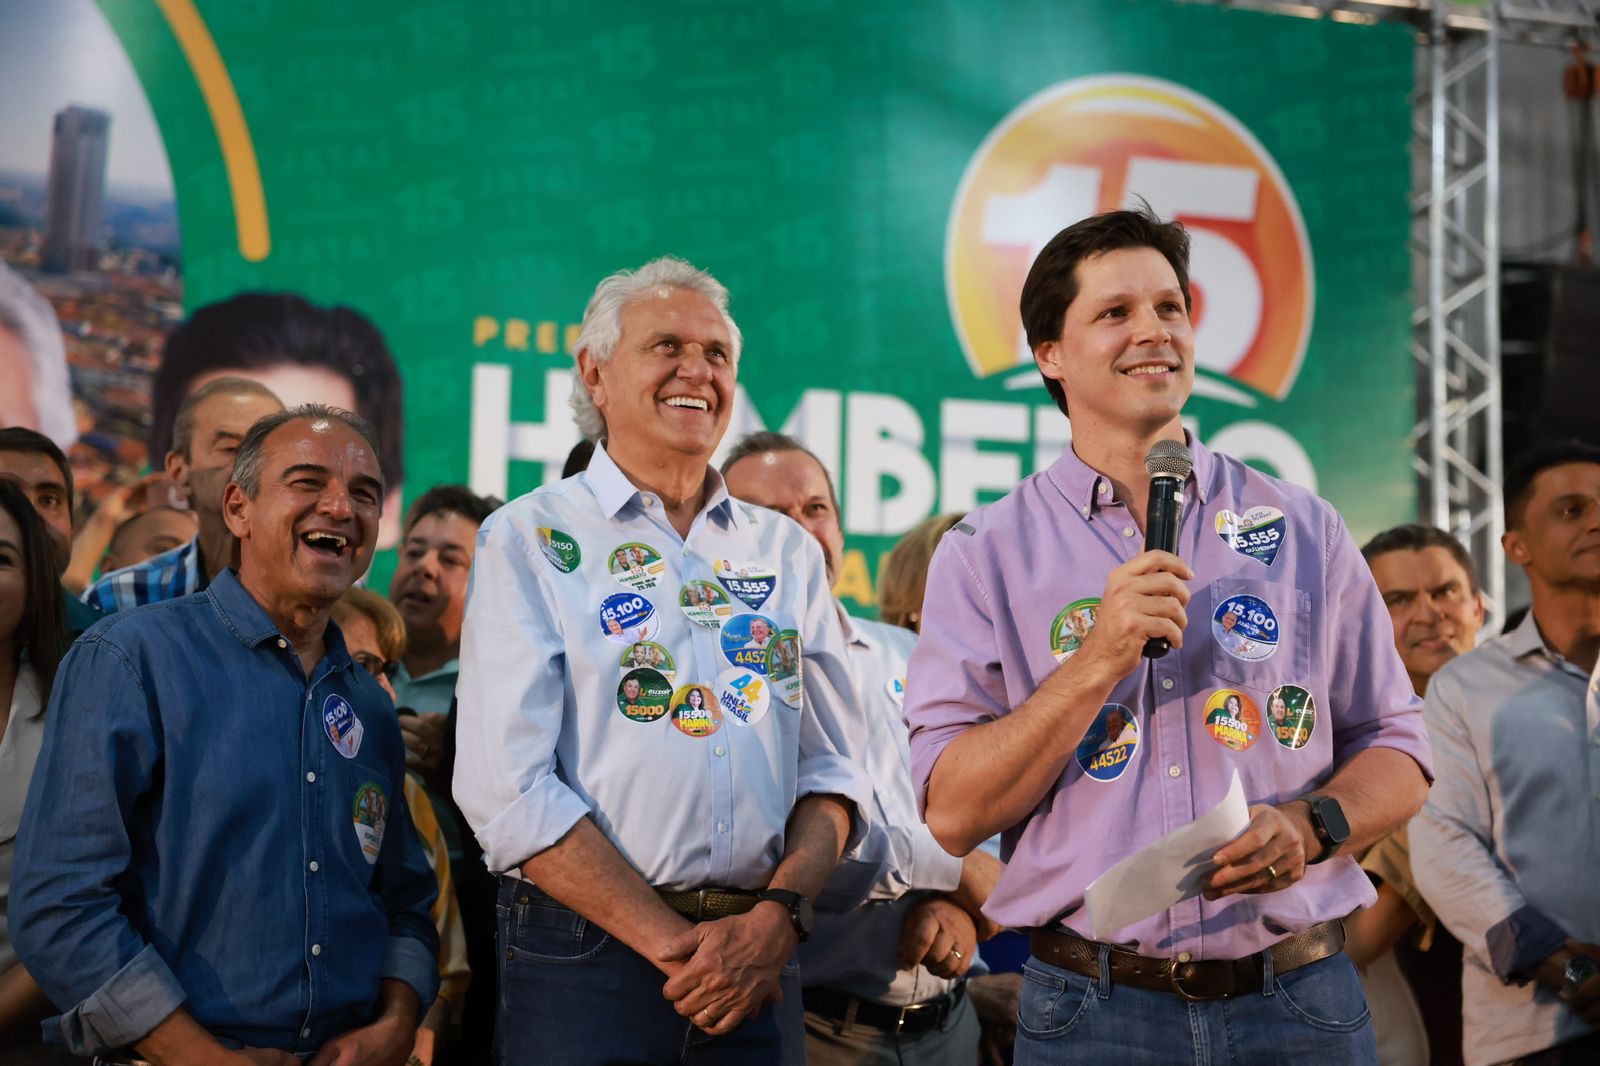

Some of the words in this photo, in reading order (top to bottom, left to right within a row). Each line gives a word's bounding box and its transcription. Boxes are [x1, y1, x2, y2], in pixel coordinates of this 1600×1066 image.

[981, 156, 1263, 373] 15
[469, 362, 1318, 536] HMBEO
[726, 580, 770, 593] 15.555
[602, 597, 644, 621] 15.100
[1228, 602, 1276, 631] 15.100
[325, 701, 347, 727] 15.100
[625, 704, 665, 717] 15000
[678, 710, 713, 719] 15500
[720, 698, 749, 723] BRASIL
[1214, 725, 1248, 744] MARINA
[1215, 715, 1248, 732] 15500
[1090, 746, 1128, 772] 44522
